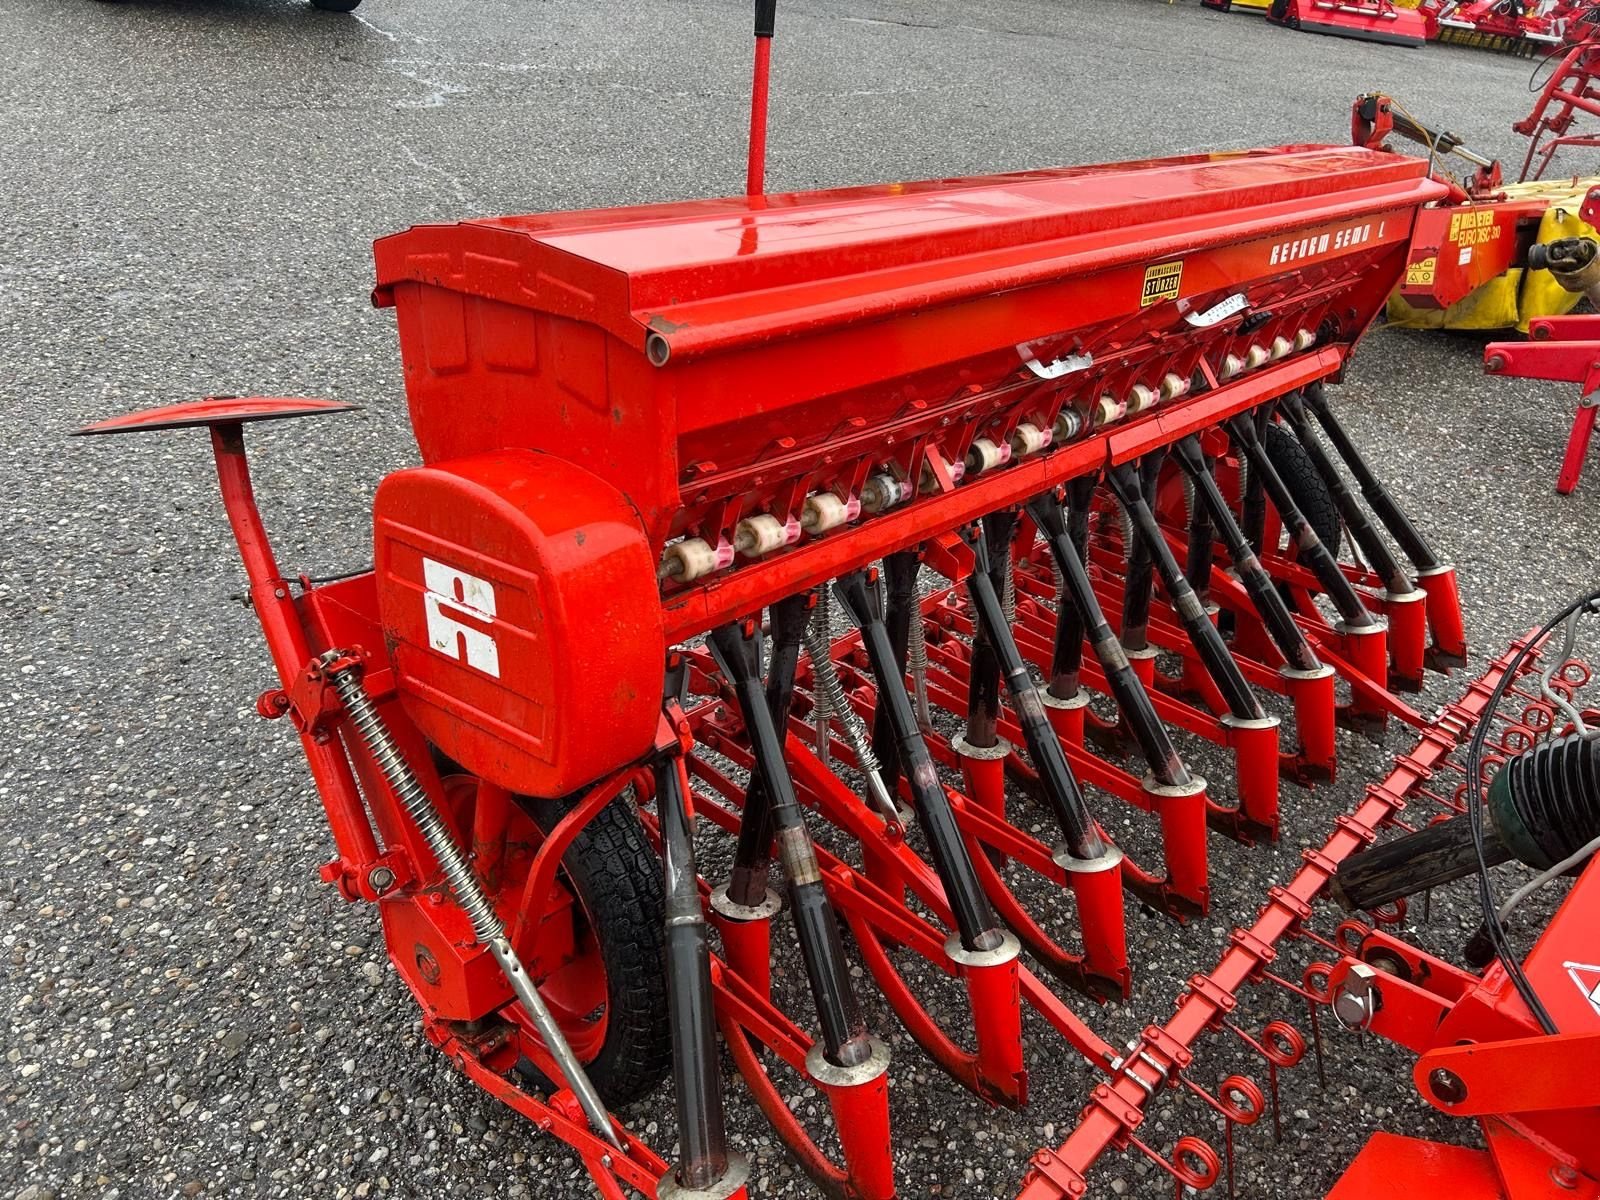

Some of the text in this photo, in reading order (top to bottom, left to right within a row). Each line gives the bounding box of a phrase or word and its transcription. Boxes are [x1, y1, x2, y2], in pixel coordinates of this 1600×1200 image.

[1269, 221, 1385, 266] REFORM SEMO L
[1146, 275, 1178, 295] STÜRZER
